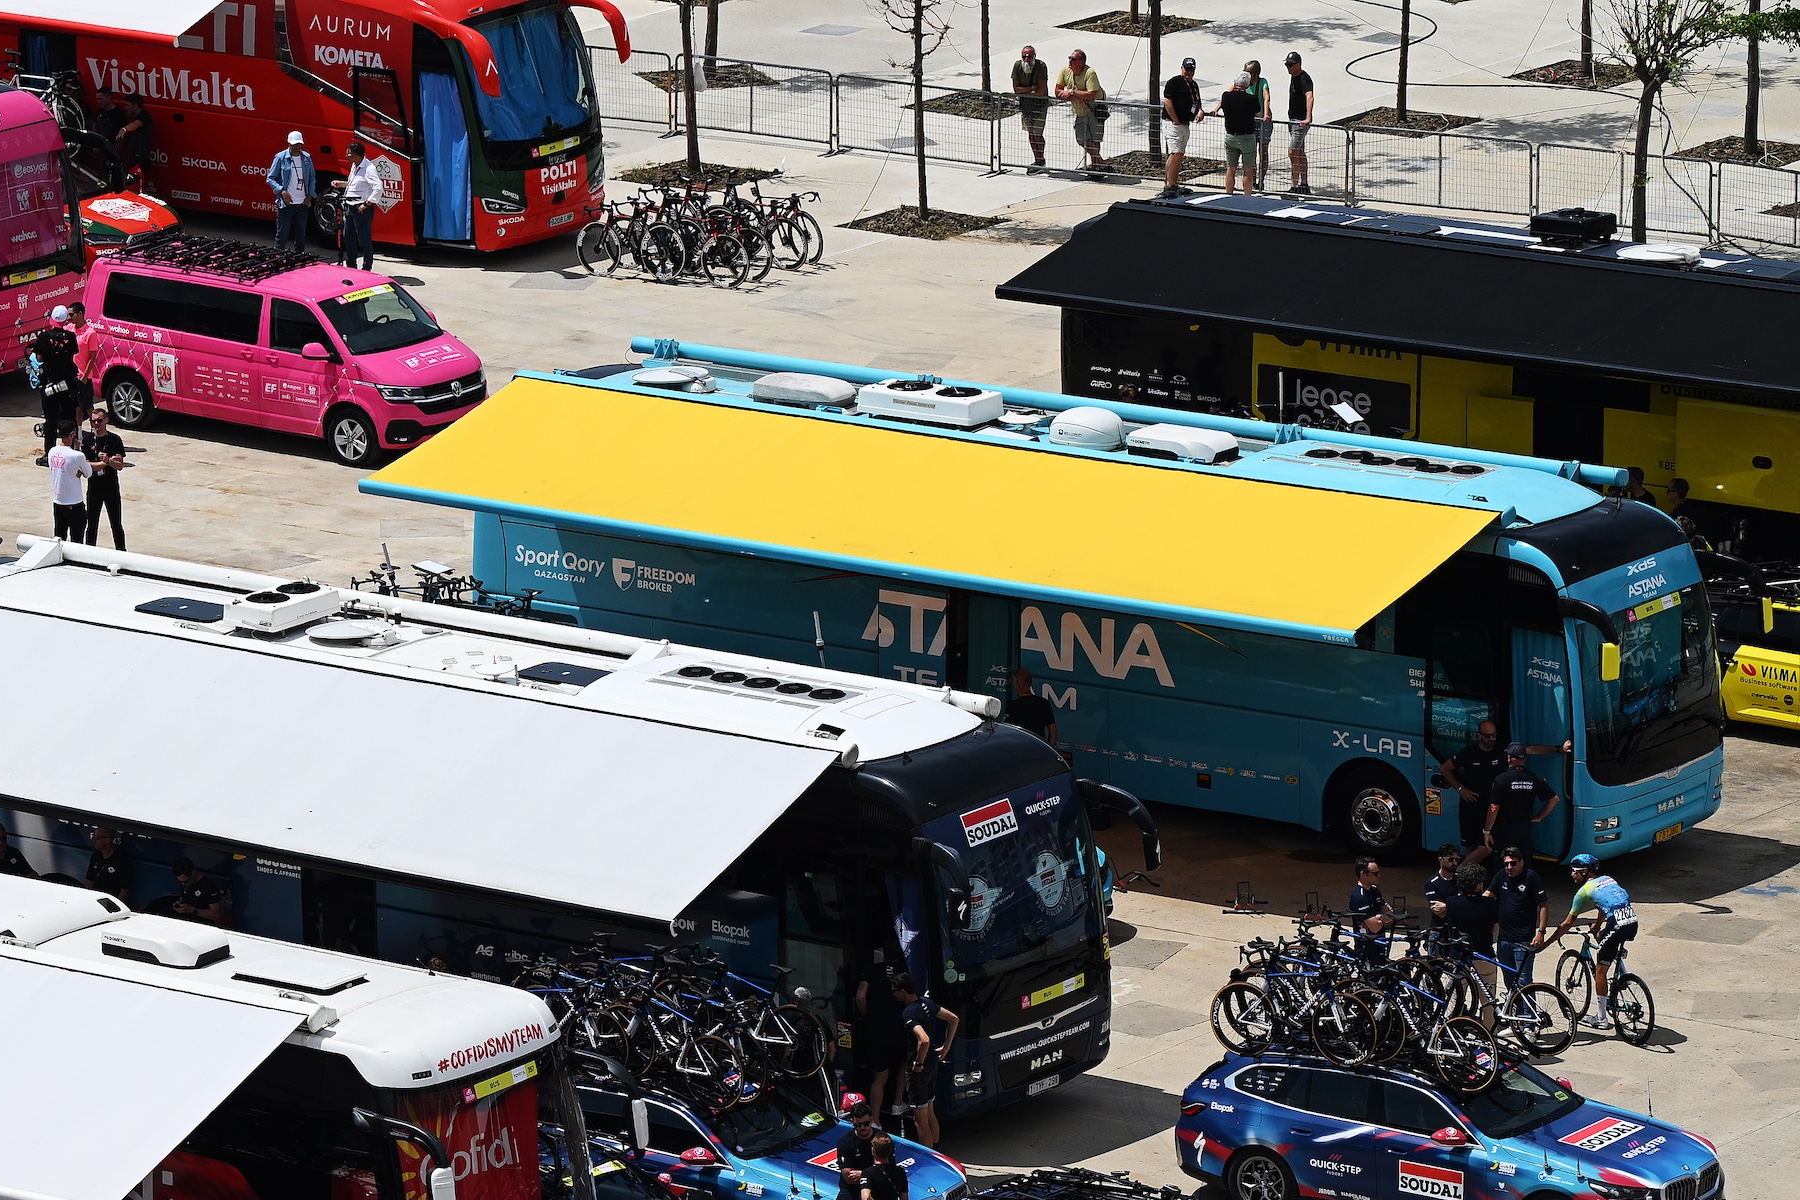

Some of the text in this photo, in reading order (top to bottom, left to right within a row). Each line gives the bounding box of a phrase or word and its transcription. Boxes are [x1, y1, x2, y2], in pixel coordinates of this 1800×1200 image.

[309, 13, 391, 42] AURUM
[314, 44, 385, 69] KOMETA
[85, 57, 257, 112] VisitMalta
[540, 159, 577, 183] POLTI
[10, 229, 38, 244] wahoo
[34, 284, 70, 303] cannondale
[109, 325, 131, 335] wahoo
[264, 382, 277, 394] EF
[1295, 378, 1373, 415] lease
[515, 543, 606, 580] Sport Qory
[533, 568, 587, 585] QAZAQSTAN
[636, 578, 673, 594] BROKER
[637, 565, 697, 587] FREEDOM
[1627, 573, 1667, 598] ASTANA
[1642, 589, 1658, 600] TEAM
[1526, 667, 1563, 685] ASTANA
[1760, 663, 1799, 683] VISMA
[1739, 676, 1799, 692] Business software
[1331, 729, 1413, 759] X-LAB
[1657, 795, 1685, 814] MAN
[967, 815, 1017, 844] SOUDAL
[710, 918, 750, 939] Ekopak
[437, 1023, 544, 1074] #COFIDISMYTEAM
[1030, 1049, 1063, 1071] MAN
[1210, 1100, 1235, 1114] Ekopak
[1579, 1121, 1639, 1151] SOUDAL
[1309, 1157, 1363, 1176] QUICK-STEP
[1399, 1175, 1463, 1200] SOUDAL
